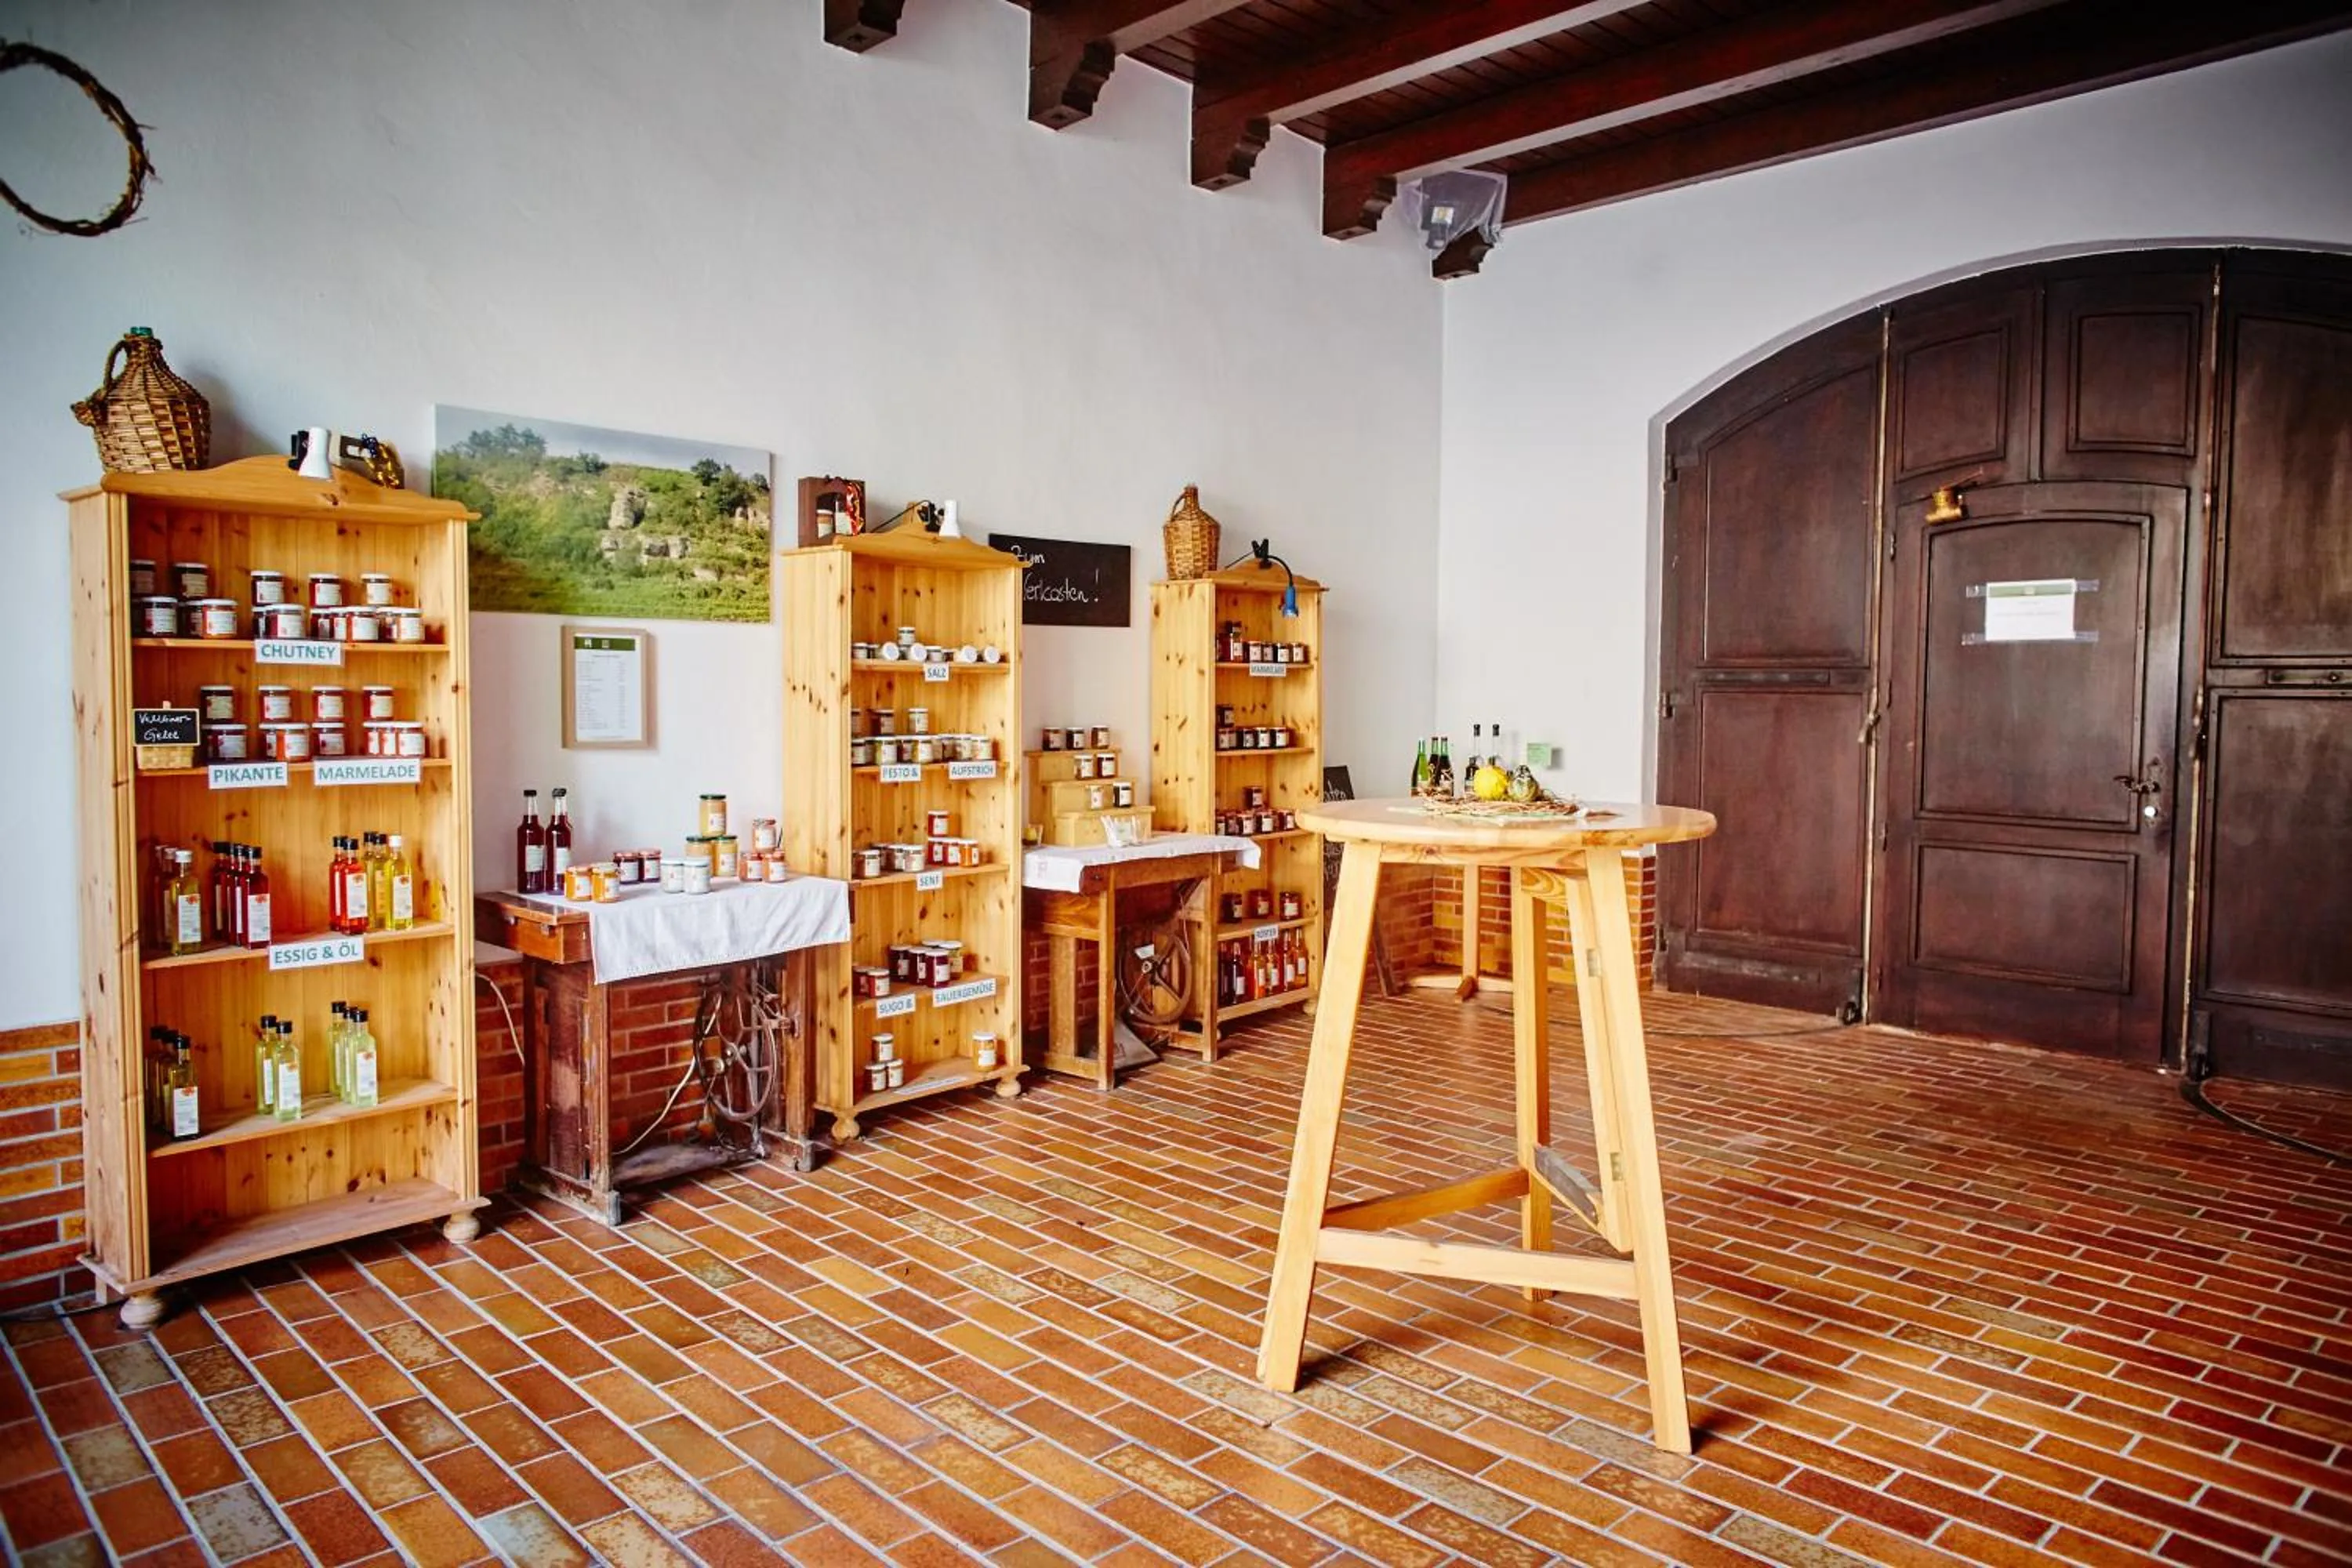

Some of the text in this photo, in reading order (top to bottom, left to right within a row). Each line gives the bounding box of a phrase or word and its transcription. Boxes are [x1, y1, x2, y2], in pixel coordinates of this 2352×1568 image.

[261, 644, 336, 659] CHUTNEY
[143, 728, 180, 742] Gelee
[213, 764, 416, 782] PIKANTE MARMELADE
[274, 942, 359, 964] ESSIG & ÖL
